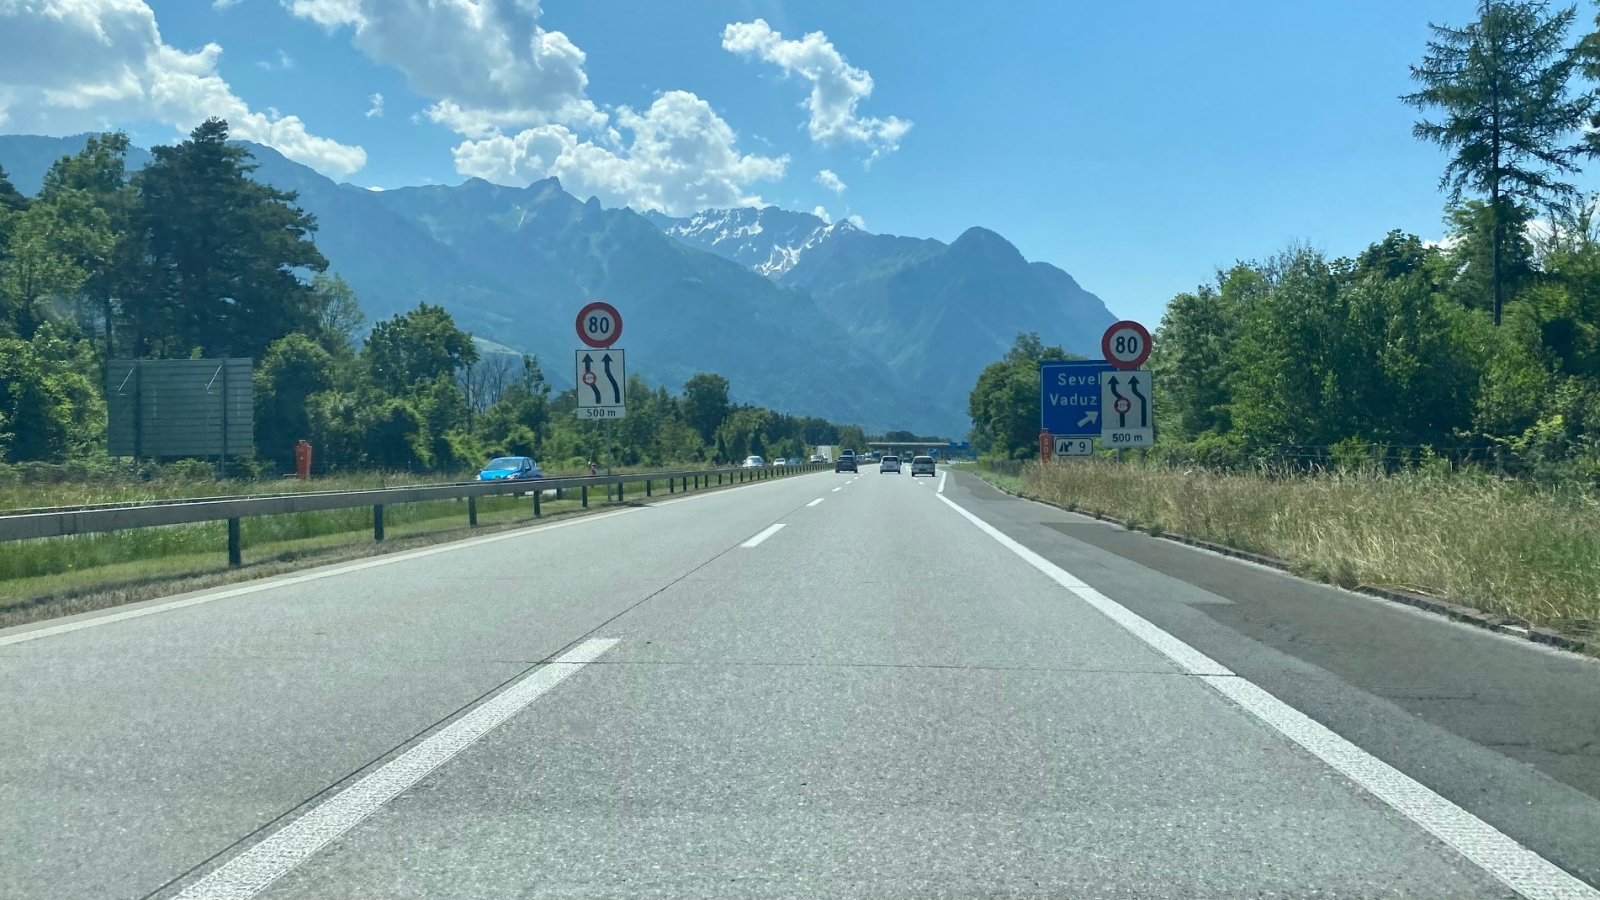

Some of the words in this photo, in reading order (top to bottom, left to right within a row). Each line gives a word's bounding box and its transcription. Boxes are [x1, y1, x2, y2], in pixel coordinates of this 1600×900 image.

[588, 316, 610, 334] 80
[1115, 336, 1138, 354] 80
[1049, 393, 1098, 406] Vaduz
[587, 409, 605, 418] 500
[1112, 433, 1131, 443] 500
[1133, 434, 1143, 442] m
[1079, 441, 1086, 453] 9
